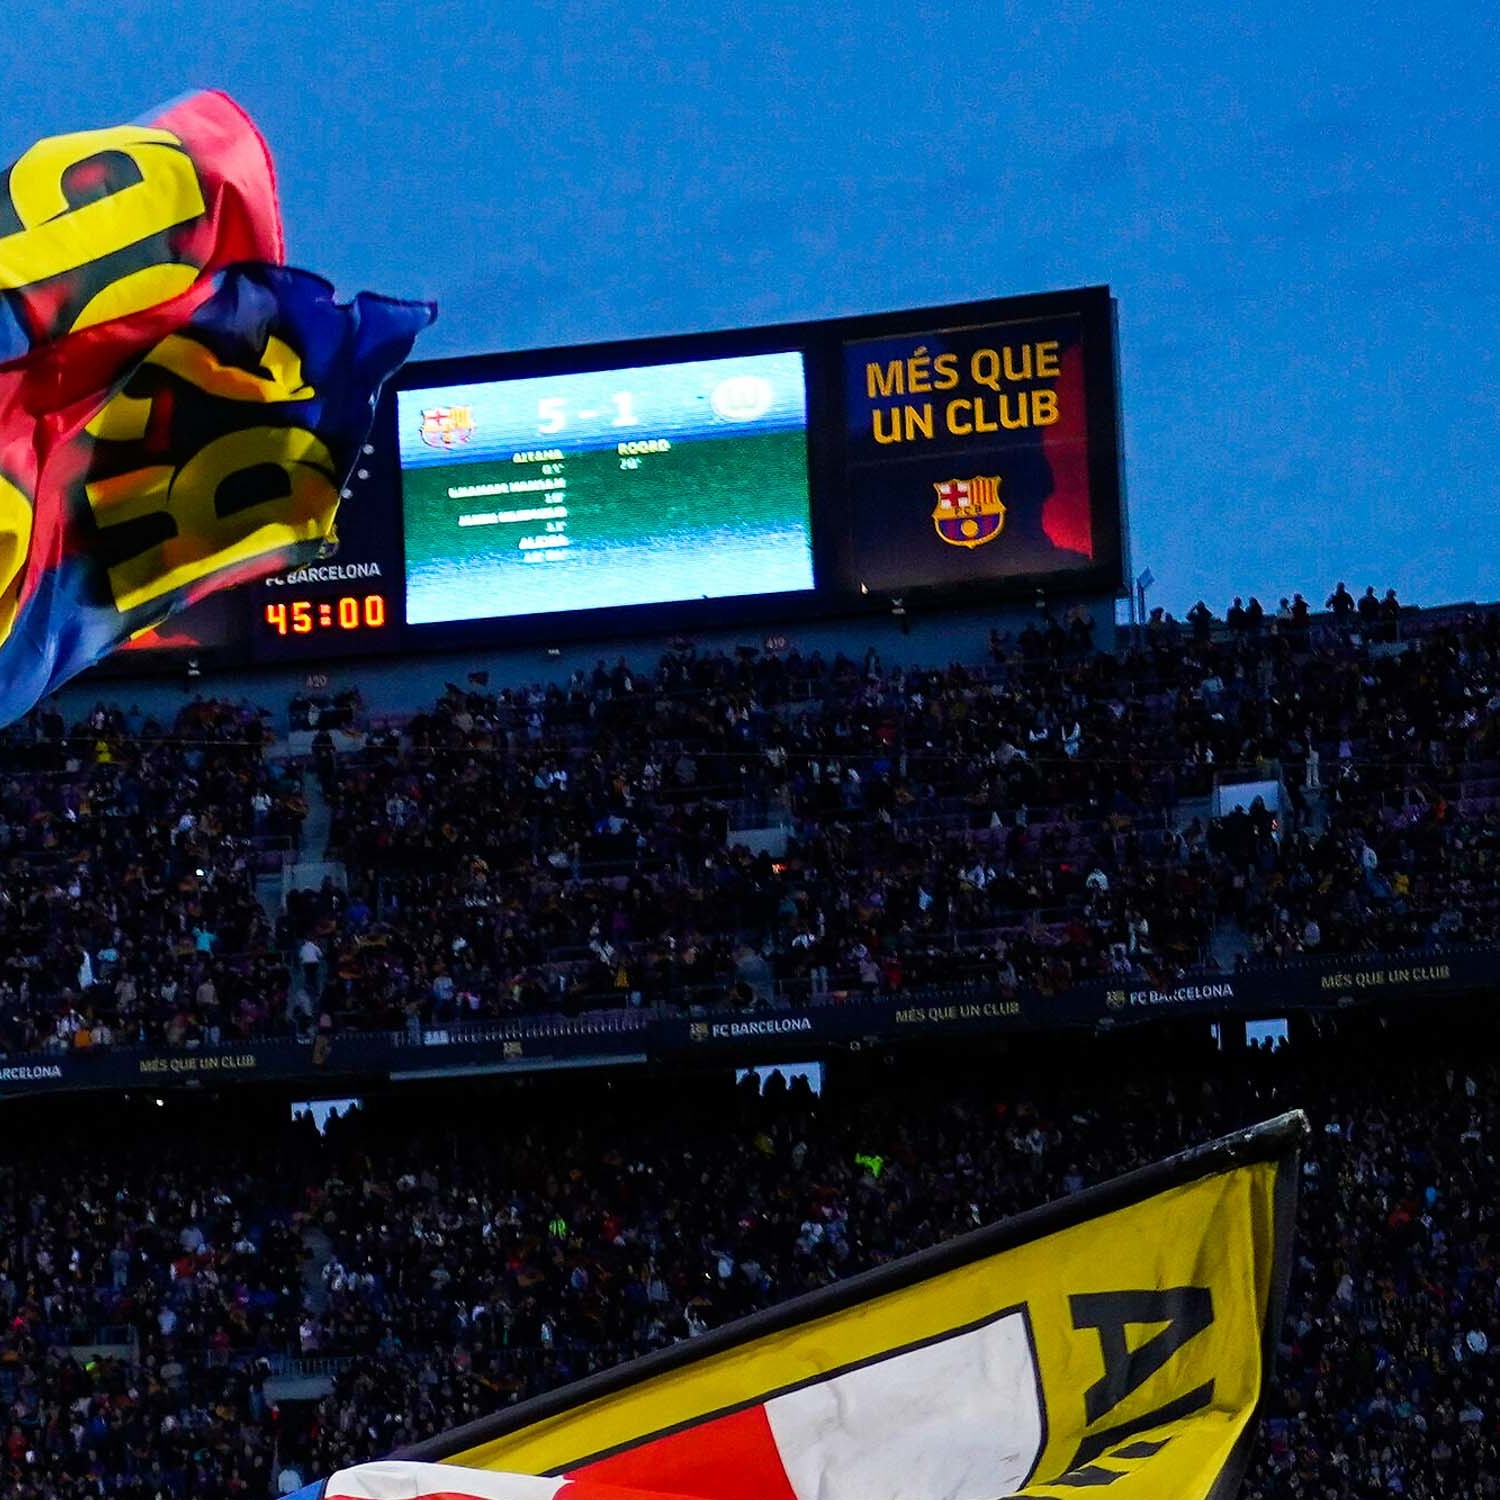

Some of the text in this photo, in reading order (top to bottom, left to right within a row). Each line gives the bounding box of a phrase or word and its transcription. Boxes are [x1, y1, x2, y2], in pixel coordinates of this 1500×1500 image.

[866, 341, 1060, 397] MÉS QUE
[539, 398, 565, 434] 5
[611, 392, 638, 427] 1
[872, 389, 1060, 444] UN CLUB
[265, 594, 385, 636] 45:00
[731, 1017, 812, 1037] BARCELONA
